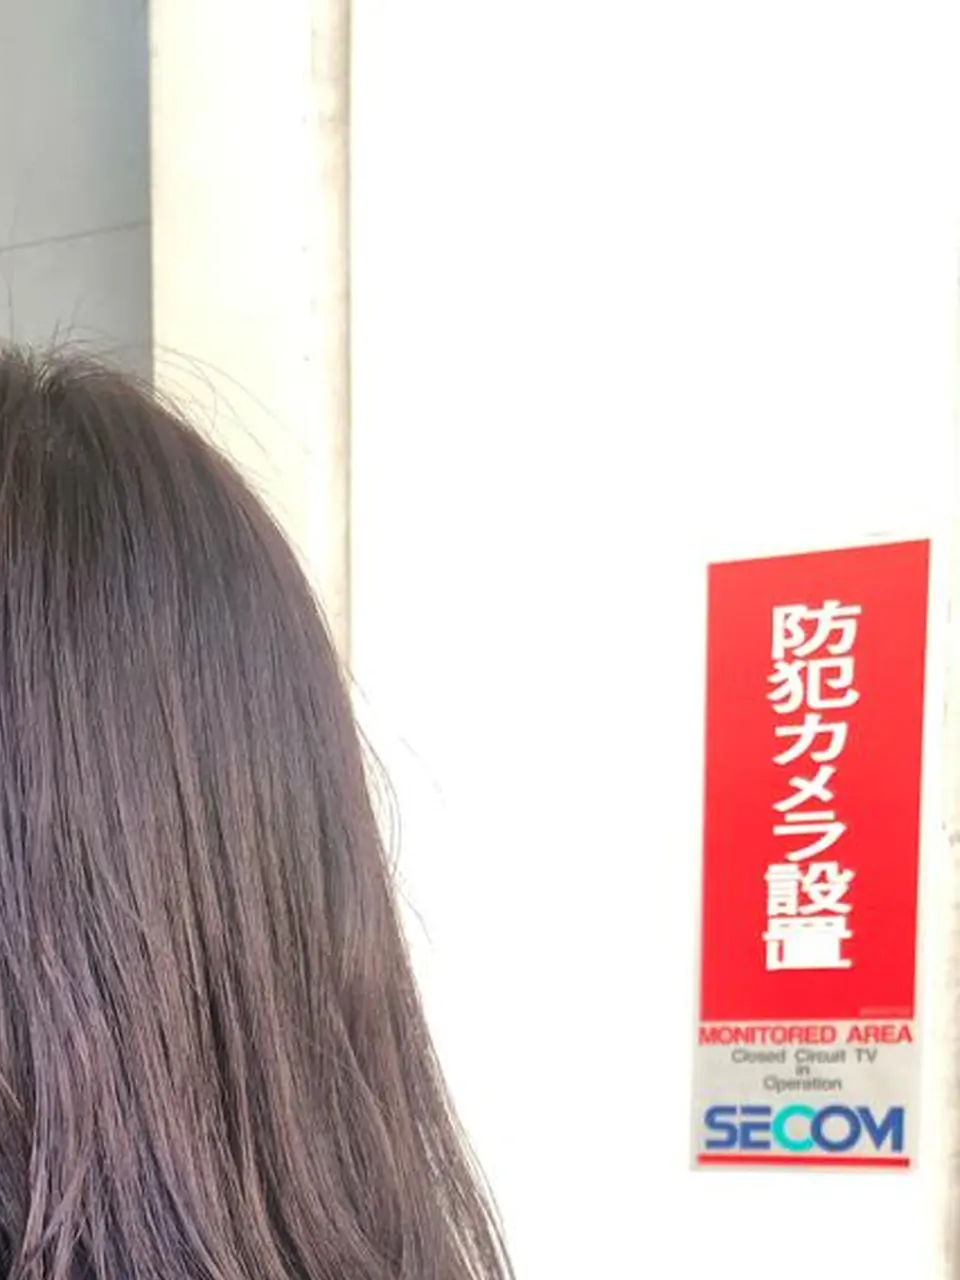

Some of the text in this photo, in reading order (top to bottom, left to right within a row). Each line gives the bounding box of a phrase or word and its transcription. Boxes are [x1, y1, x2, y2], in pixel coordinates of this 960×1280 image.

[762, 600, 861, 970] 防犯カメラ設置
[699, 1025, 913, 1045] MONITORED AREA
[731, 1049, 878, 1063] Closed Circuit TV
[796, 1064, 810, 1075] in
[763, 1076, 842, 1093] Operation
[704, 1104, 904, 1152] SECOM
